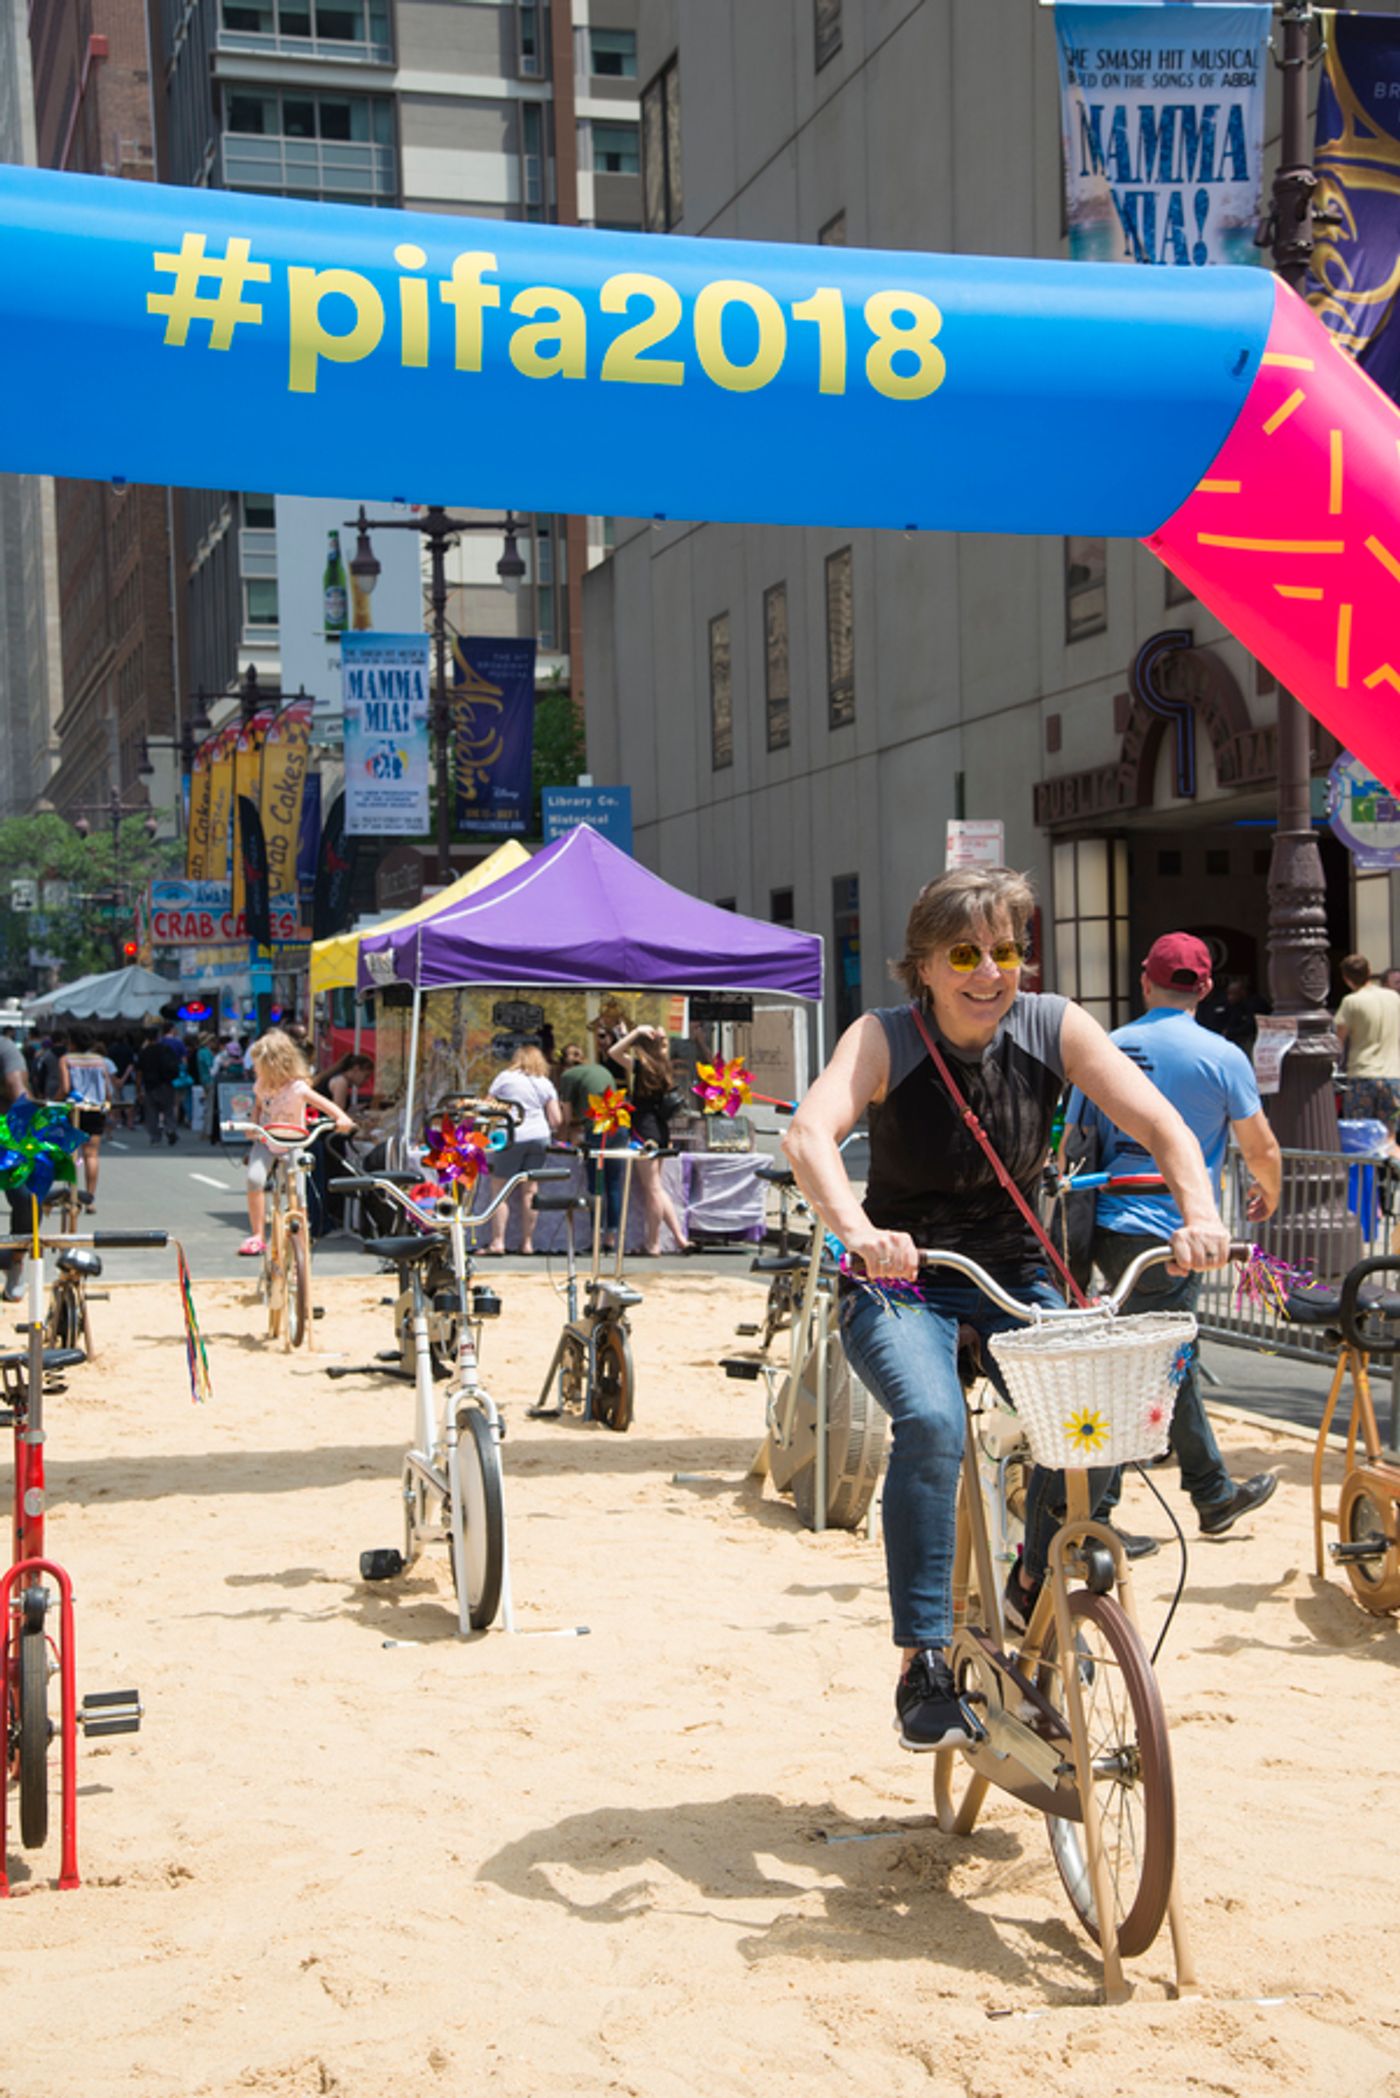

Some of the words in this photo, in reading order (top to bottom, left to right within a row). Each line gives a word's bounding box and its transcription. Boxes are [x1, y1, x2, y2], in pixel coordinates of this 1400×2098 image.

[1096, 48, 1152, 70] SMASH
[1158, 48, 1185, 70] HIT
[1191, 48, 1259, 70] MUSICAL
[1102, 72, 1120, 88] ON
[1124, 72, 1146, 89] THE
[1152, 71, 1194, 89] SONGS
[1199, 71, 1215, 88] OF
[1221, 72, 1257, 88] ABBA
[146, 231, 947, 400] #pifa2018
[348, 669, 424, 701] MAMMA
[365, 702, 410, 732] MIA!
[270, 752, 305, 825] Cakes
[548, 796, 592, 808] Library
[597, 795, 619, 807] Co.
[548, 813, 608, 824] Historical
[154, 911, 215, 939] CRAB
[221, 911, 294, 939] CAES
